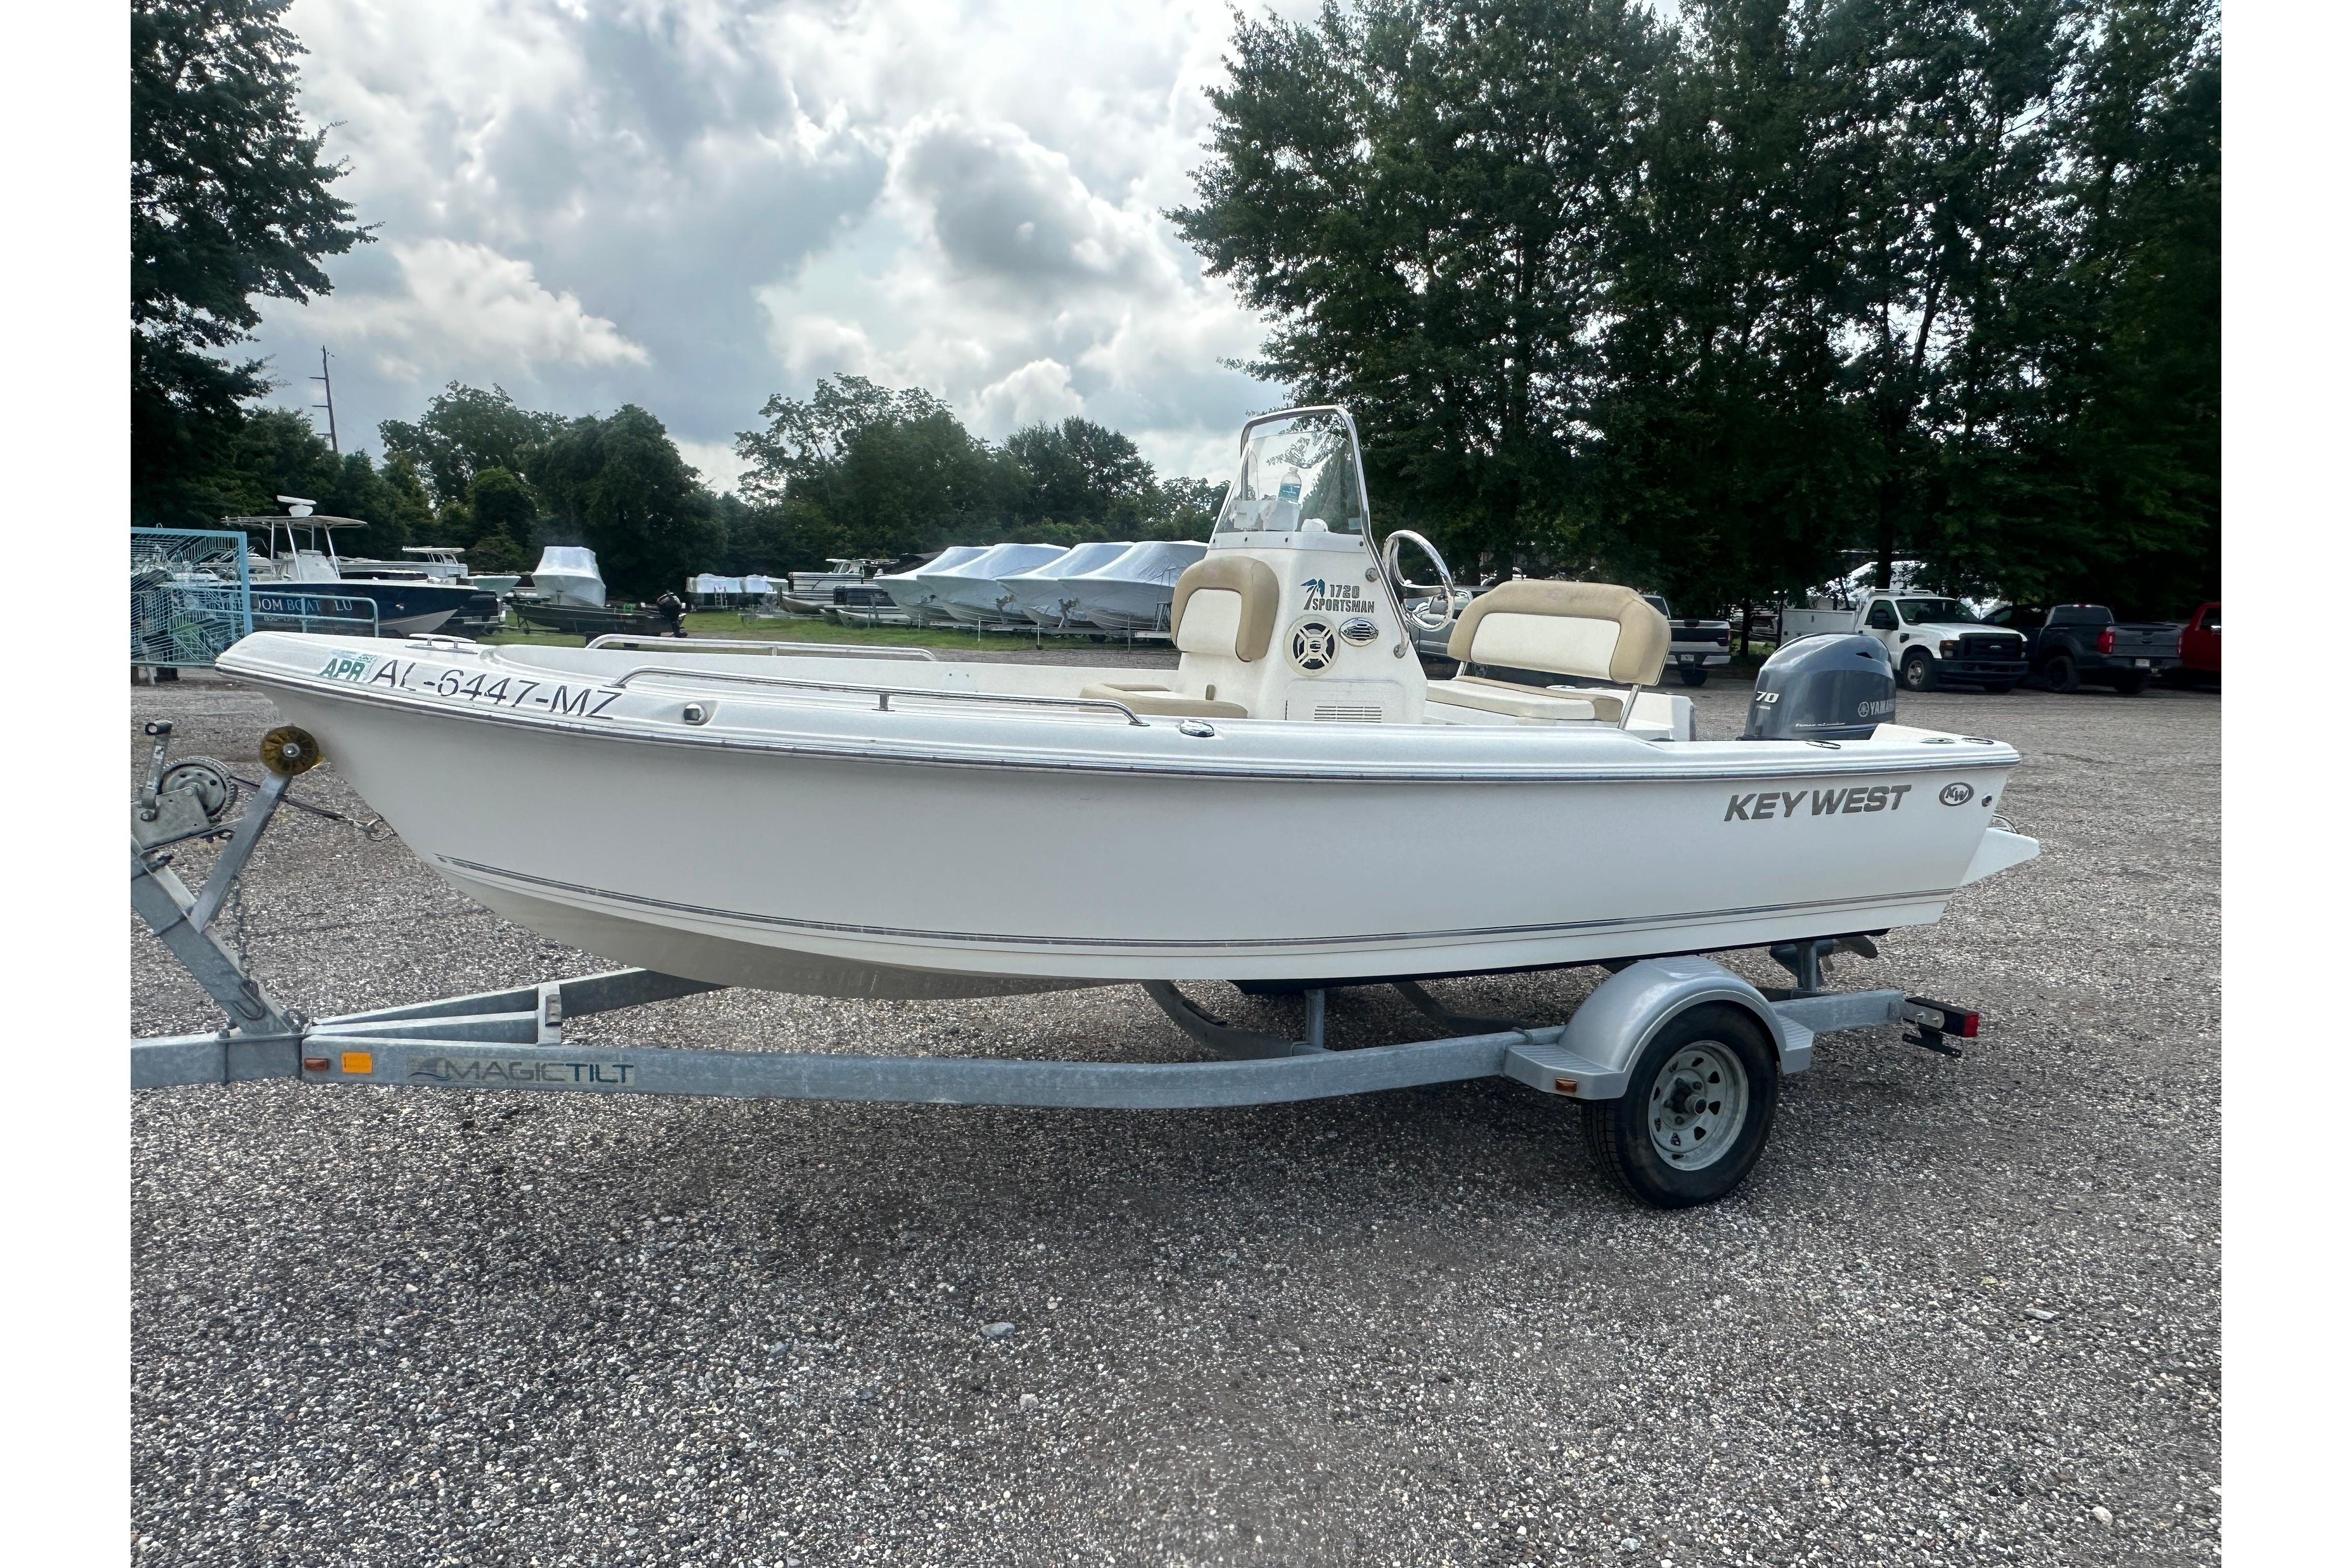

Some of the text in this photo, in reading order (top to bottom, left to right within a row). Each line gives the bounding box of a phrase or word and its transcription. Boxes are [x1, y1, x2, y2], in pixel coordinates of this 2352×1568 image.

[1330, 584, 1360, 598] 1720
[334, 599, 353, 611] LU
[1312, 598, 1375, 613] SPORTSMAN
[319, 658, 366, 681] APR
[1756, 691, 1780, 703] 70
[1724, 785, 1912, 822] KEY WEST
[444, 1060, 634, 1083] MAGICTILT
